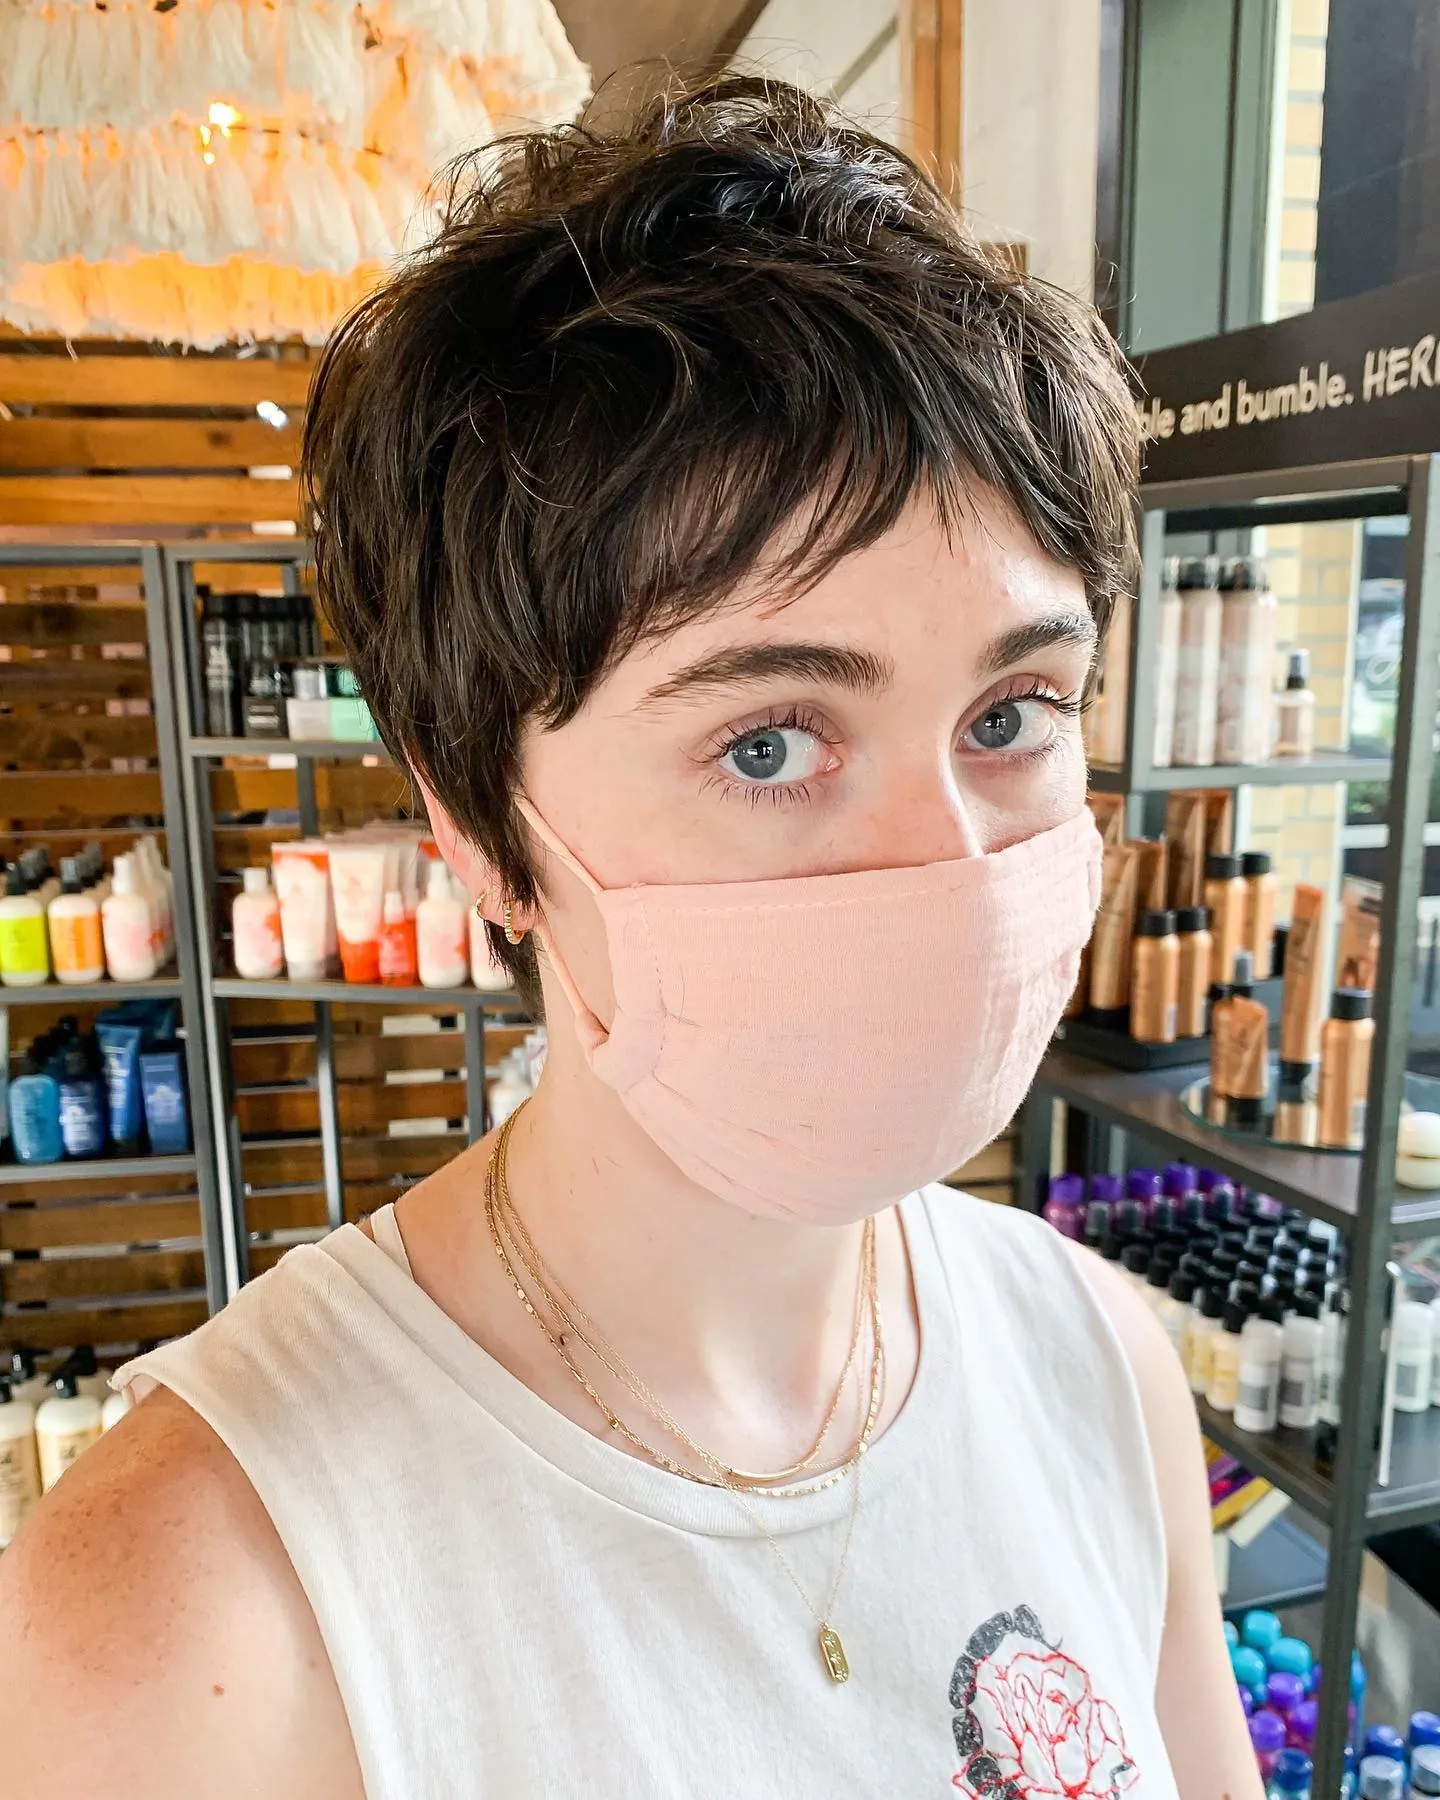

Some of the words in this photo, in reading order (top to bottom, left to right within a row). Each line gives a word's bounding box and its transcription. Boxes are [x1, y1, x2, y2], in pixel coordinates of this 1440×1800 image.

[1135, 396, 1176, 441] ble
[1180, 382, 1232, 435] and
[1236, 360, 1354, 424] bumble.
